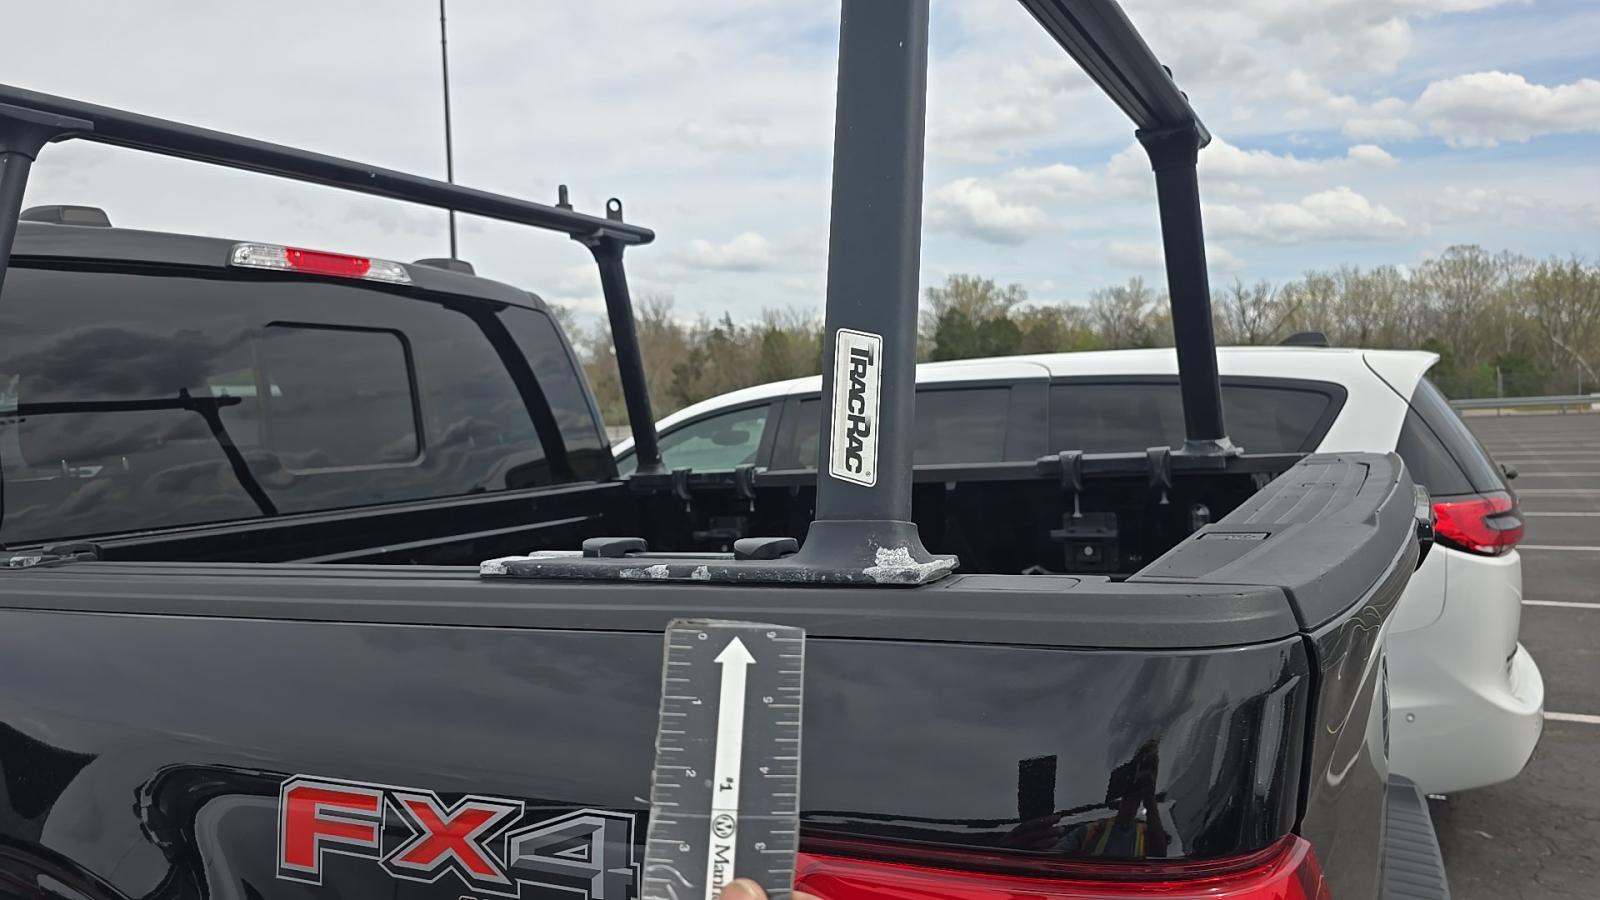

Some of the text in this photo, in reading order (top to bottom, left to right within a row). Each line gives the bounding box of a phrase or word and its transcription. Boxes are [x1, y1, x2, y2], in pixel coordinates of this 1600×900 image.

[845, 347, 874, 473] TRACRAC
[685, 769, 697, 778] 2
[759, 766, 770, 774] 4
[277, 773, 641, 900] FX4
[679, 843, 691, 852] 3
[754, 841, 767, 850] 3
